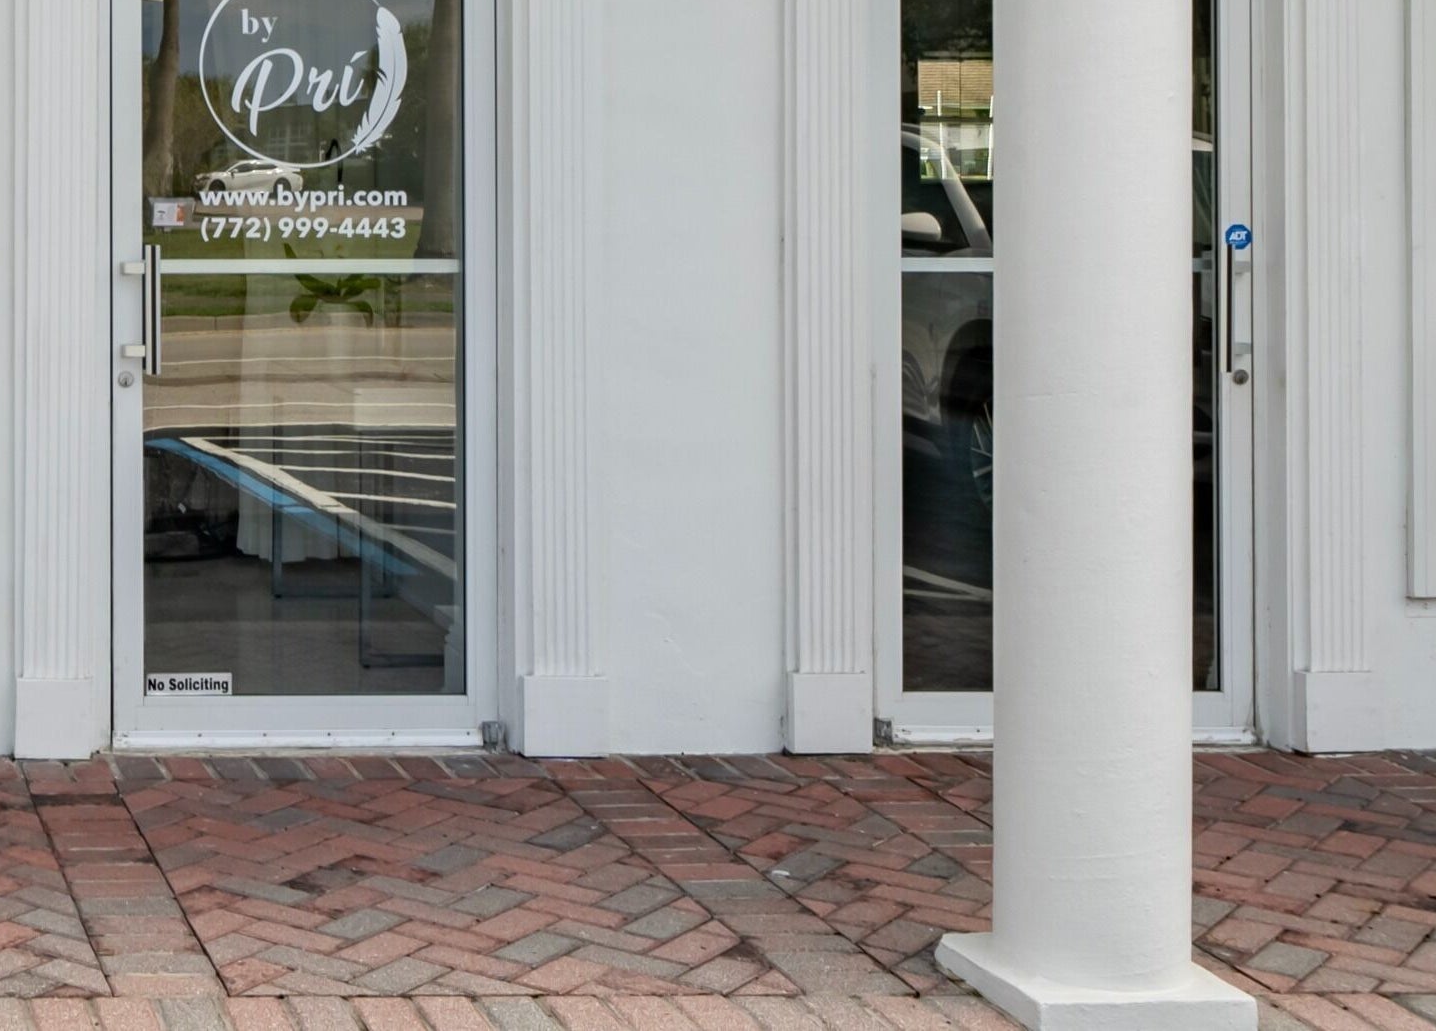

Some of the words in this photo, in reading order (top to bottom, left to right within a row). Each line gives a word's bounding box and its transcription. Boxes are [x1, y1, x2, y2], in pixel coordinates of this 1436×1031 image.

[241, 8, 278, 43] by
[231, 47, 368, 137] Prí
[199, 183, 408, 212] www.bypri.com
[199, 217, 271, 242] (772)
[278, 217, 407, 239] 999-4443
[1228, 230, 1248, 241] ADT
[148, 678, 165, 691] No
[168, 677, 229, 693] Soliciting
